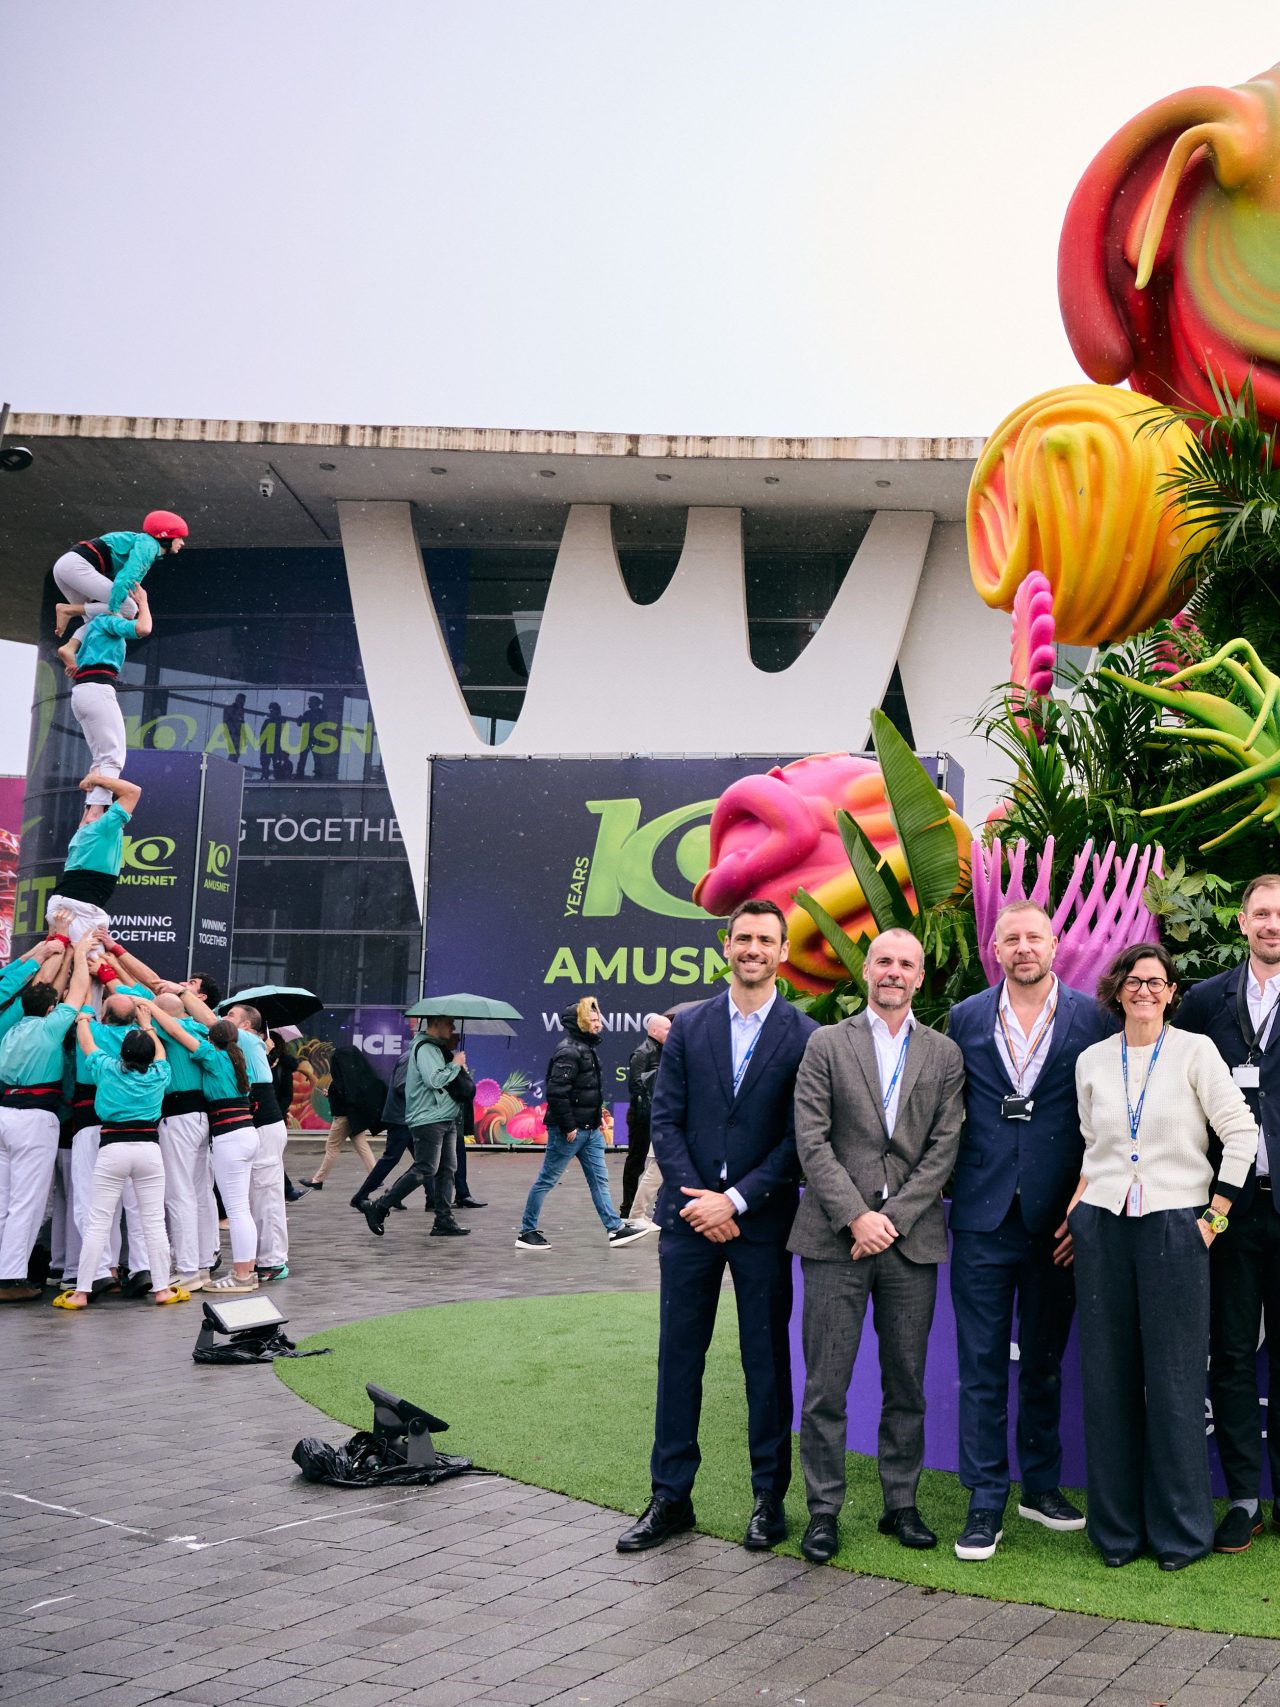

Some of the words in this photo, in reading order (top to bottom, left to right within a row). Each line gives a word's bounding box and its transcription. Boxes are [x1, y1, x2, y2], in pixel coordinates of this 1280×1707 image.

[205, 721, 380, 755] AMUSN
[116, 875, 177, 886] MUSNET
[203, 878, 230, 893] AMUSNET
[564, 856, 590, 918] YEARS
[108, 915, 172, 927] WINNING
[201, 918, 227, 932] WINNING
[199, 933, 227, 947] TOGETHER
[542, 1012, 660, 1032] WNIN
[353, 1034, 402, 1055] ICE
